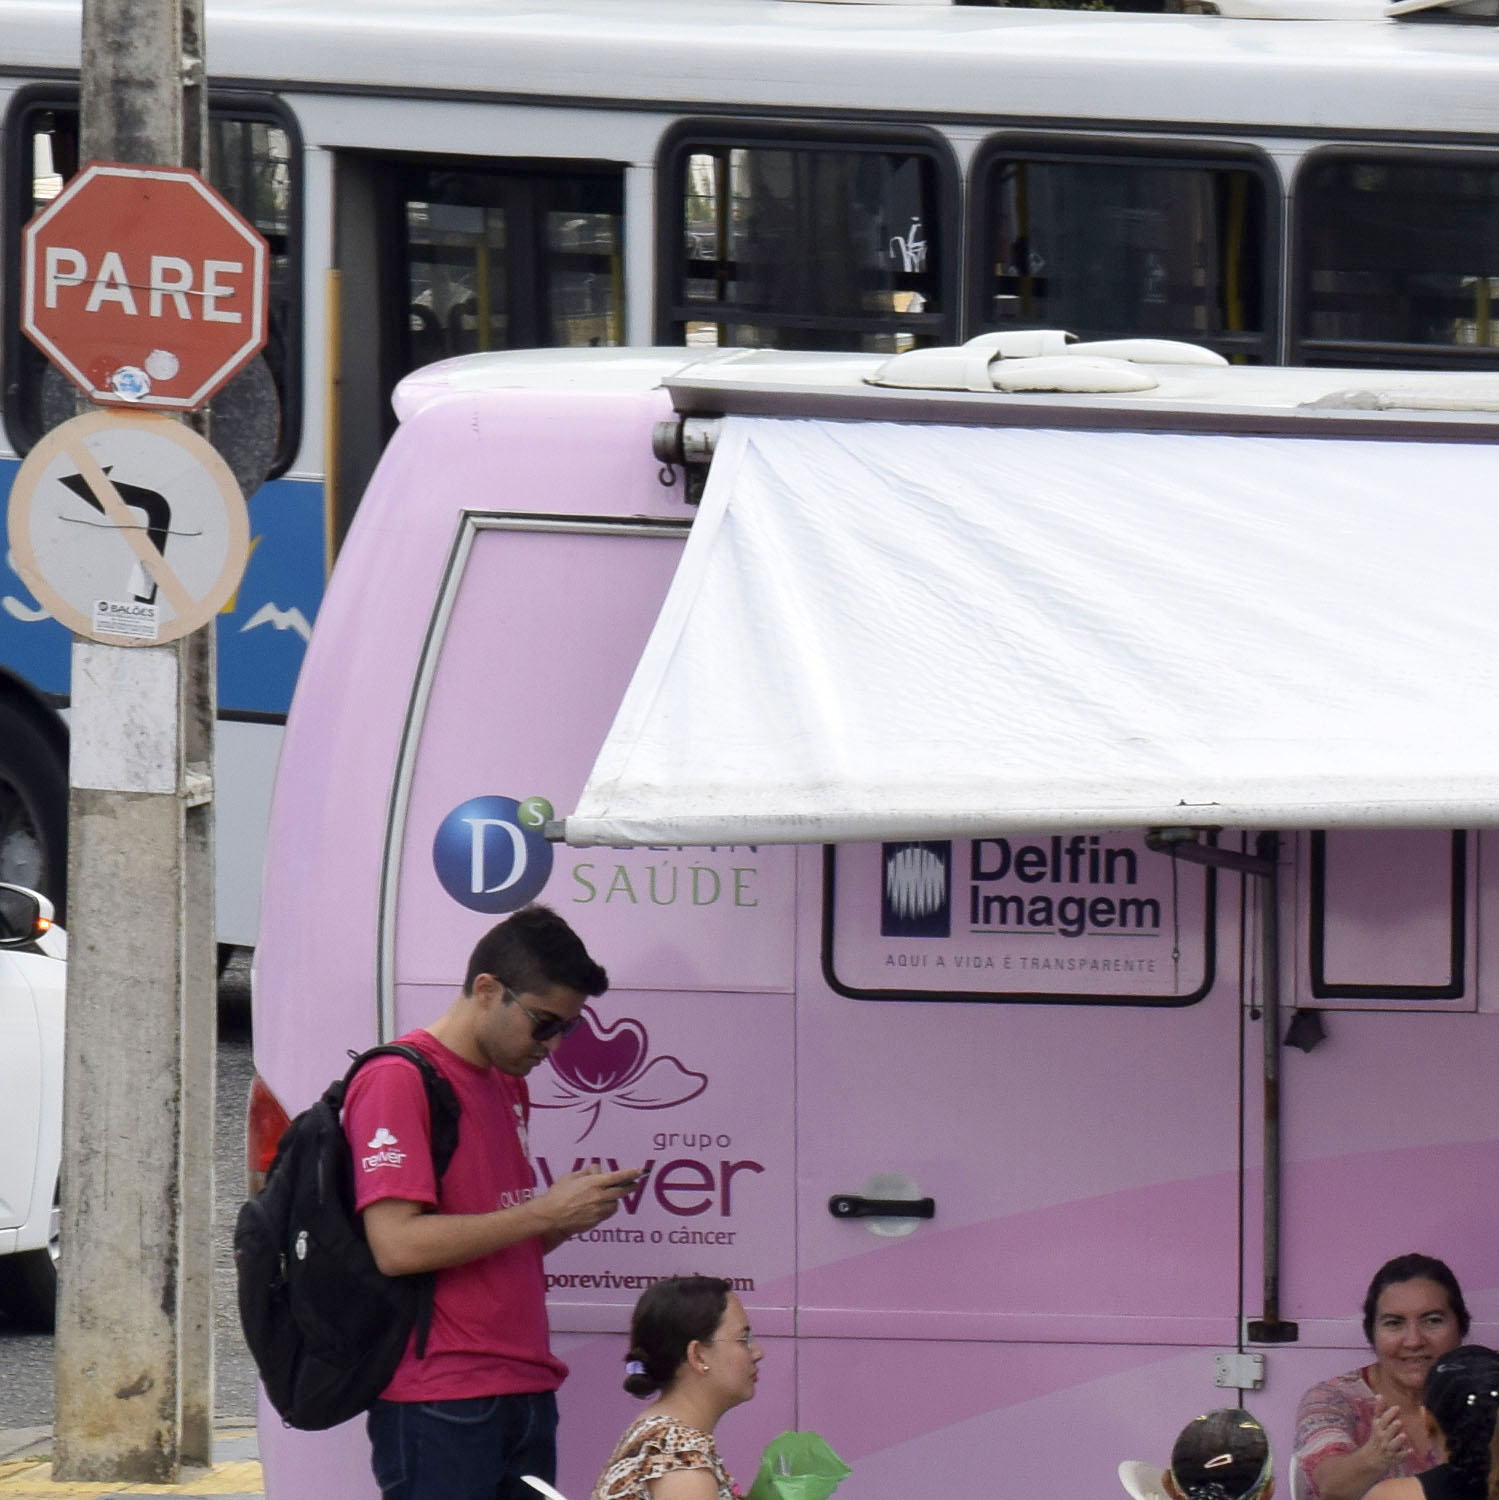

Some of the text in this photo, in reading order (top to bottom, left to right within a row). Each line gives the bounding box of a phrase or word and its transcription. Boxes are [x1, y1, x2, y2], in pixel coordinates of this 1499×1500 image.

[45, 246, 243, 324] PARE
[571, 859, 758, 908] SAÚDE
[970, 835, 1137, 885] Delfin
[970, 884, 1160, 938] Imagem
[886, 953, 1156, 973] AQUI A VIDA É TRANSPARENTE
[653, 1132, 732, 1151] grupo
[650, 1230, 663, 1245] o
[668, 1226, 737, 1246] câncer
